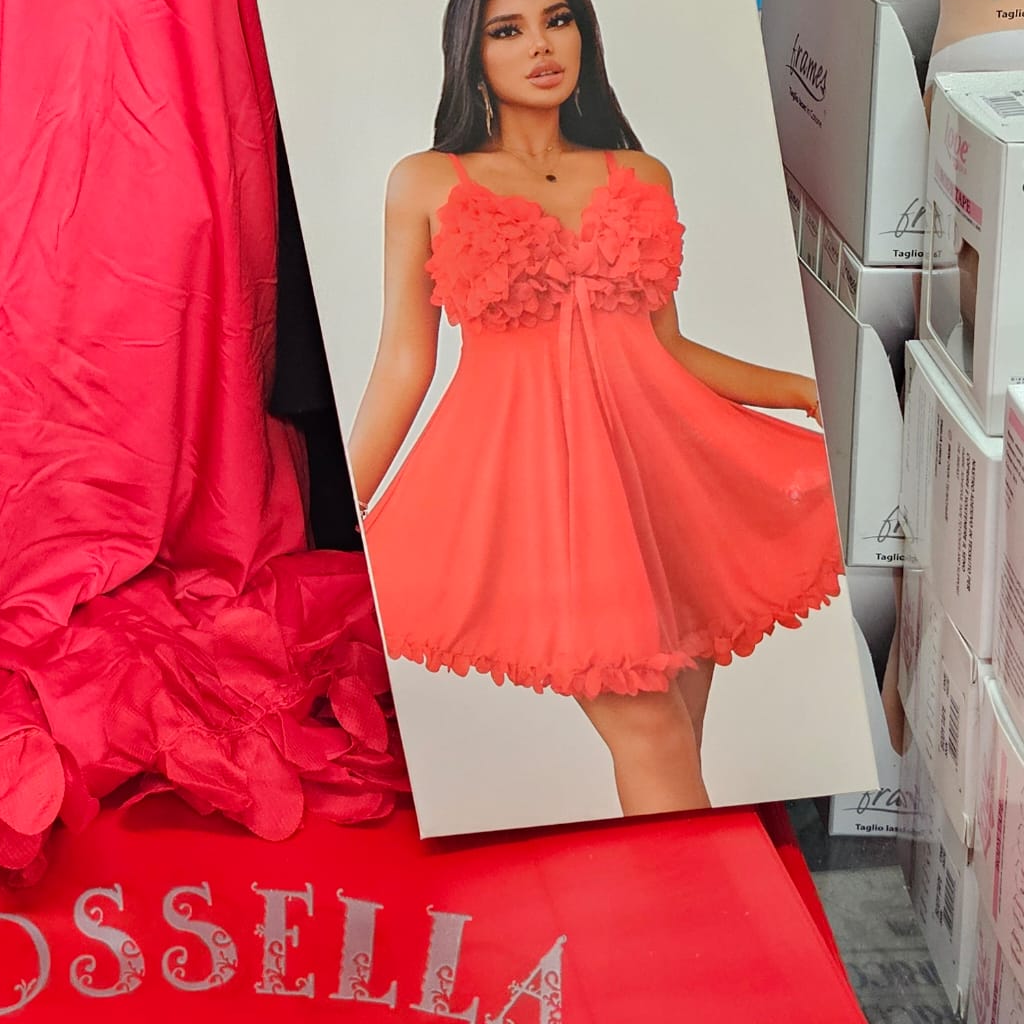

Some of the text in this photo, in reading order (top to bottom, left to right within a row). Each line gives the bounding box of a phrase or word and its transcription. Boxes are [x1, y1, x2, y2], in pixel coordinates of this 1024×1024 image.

[955, 185, 972, 215] TAPE
[893, 249, 924, 260] Taglio
[855, 823, 884, 833] Taglio
